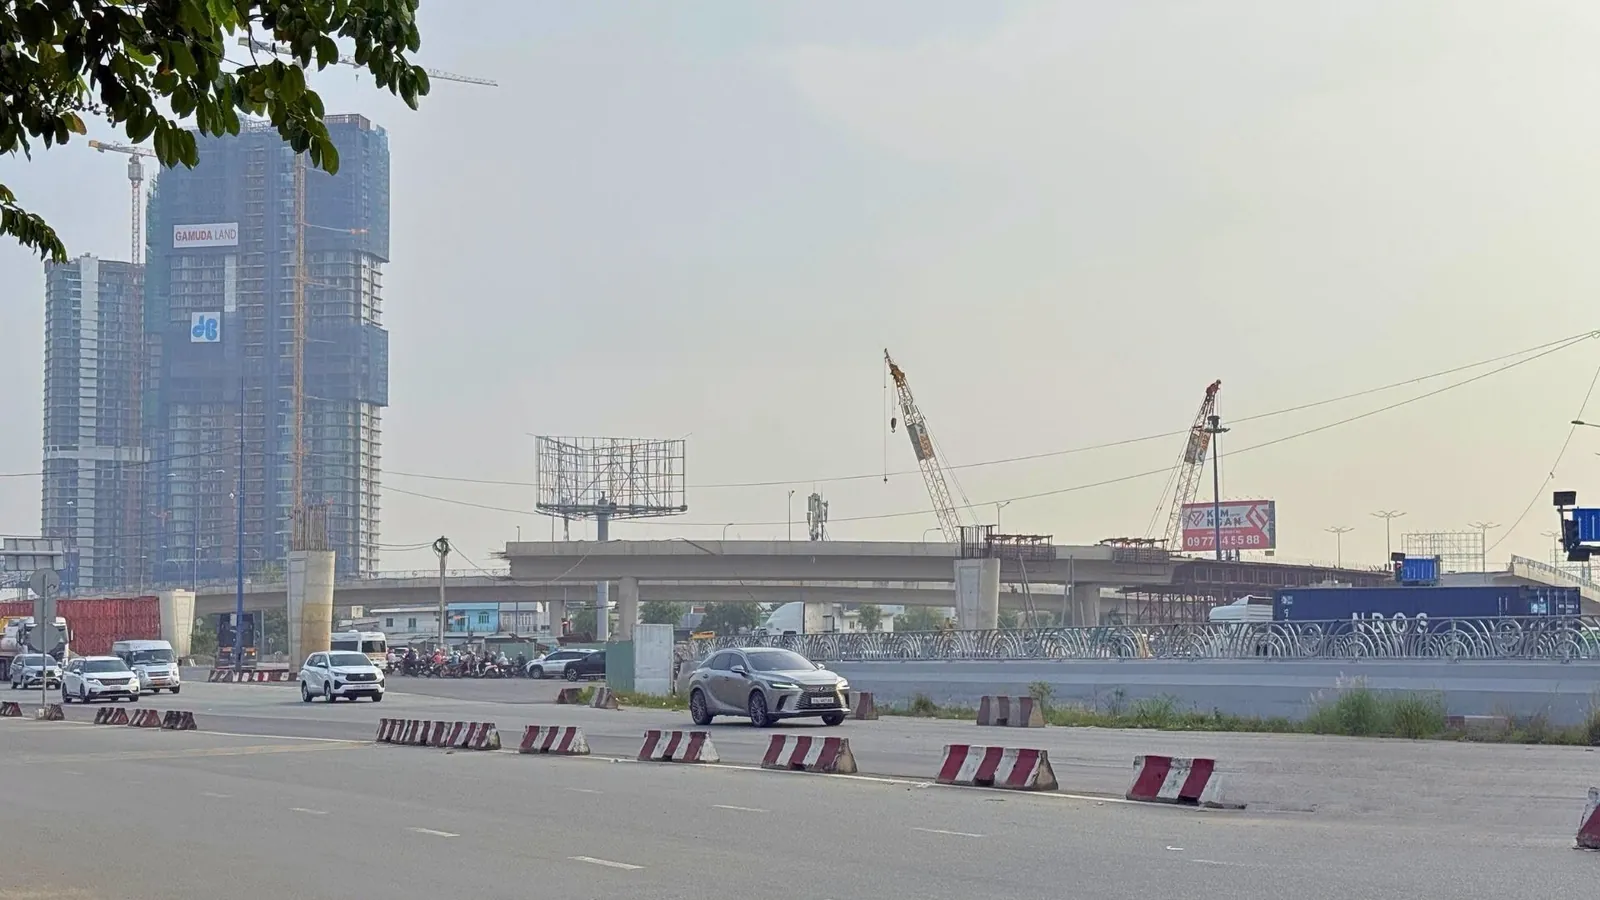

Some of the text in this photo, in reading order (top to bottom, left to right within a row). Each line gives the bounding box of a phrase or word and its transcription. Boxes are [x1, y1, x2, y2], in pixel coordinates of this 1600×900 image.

[175, 229, 237, 242] GAMUDA LAND
[1206, 509, 1229, 518] KM
